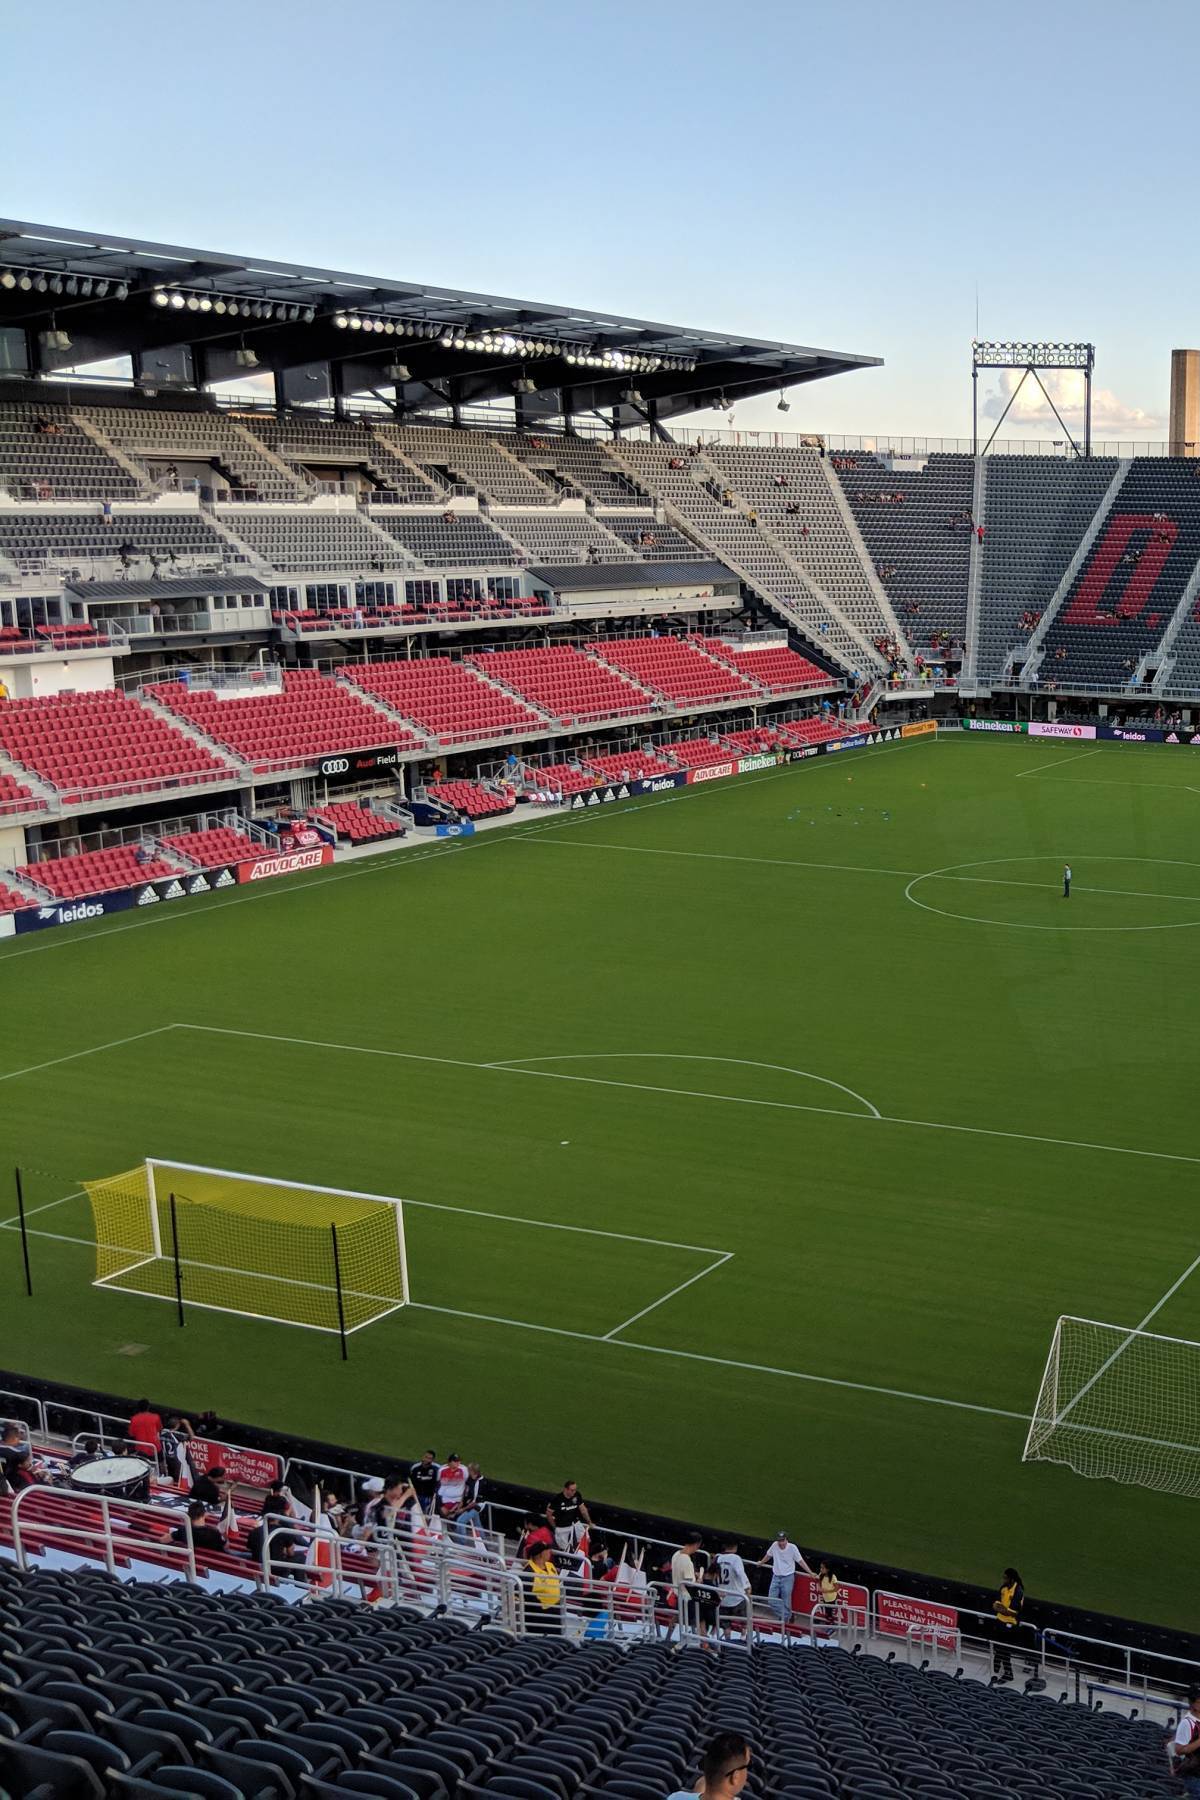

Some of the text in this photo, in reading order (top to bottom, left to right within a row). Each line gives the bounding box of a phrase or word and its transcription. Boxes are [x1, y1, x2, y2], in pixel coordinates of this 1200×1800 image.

[969, 719, 1014, 732] Heineken
[1041, 725, 1073, 736] SAFEWAY
[1122, 731, 1146, 741] leidos
[356, 754, 396, 769] Audi Field
[737, 755, 777, 773] Heineken
[692, 762, 733, 782] ADVOCARE
[651, 778, 675, 792] leidos
[250, 849, 323, 880] ADVOCARE
[58, 901, 105, 924] leidos
[882, 1599, 913, 1612] PLEASE
